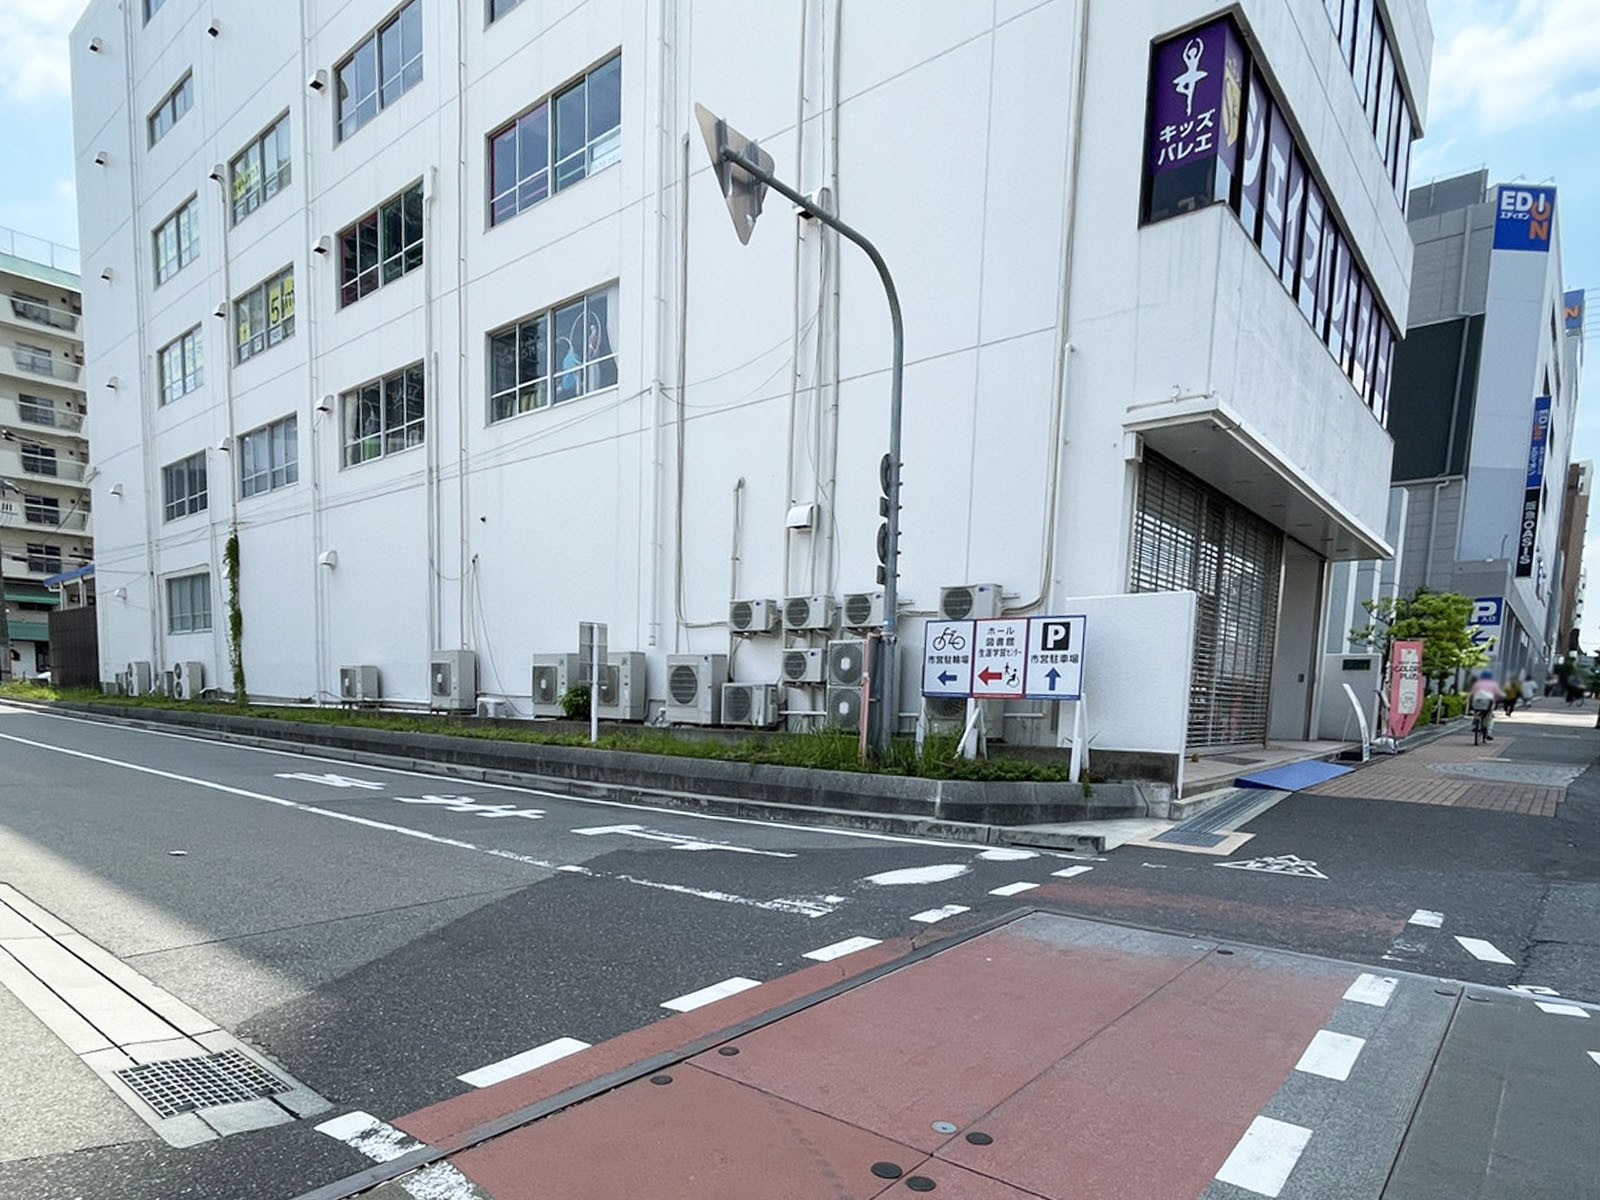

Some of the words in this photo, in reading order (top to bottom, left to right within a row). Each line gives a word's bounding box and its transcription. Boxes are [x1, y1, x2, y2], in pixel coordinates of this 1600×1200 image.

[1159, 108, 1216, 143] キッズ
[1157, 132, 1213, 166] バレエ
[1500, 190, 1551, 240] EDION
[1470, 601, 1498, 623] P
[986, 626, 1015, 635] ホール
[1046, 624, 1066, 649] P
[928, 655, 970, 665] 市営駐輪場
[1030, 653, 1079, 664] 市営駐車場
